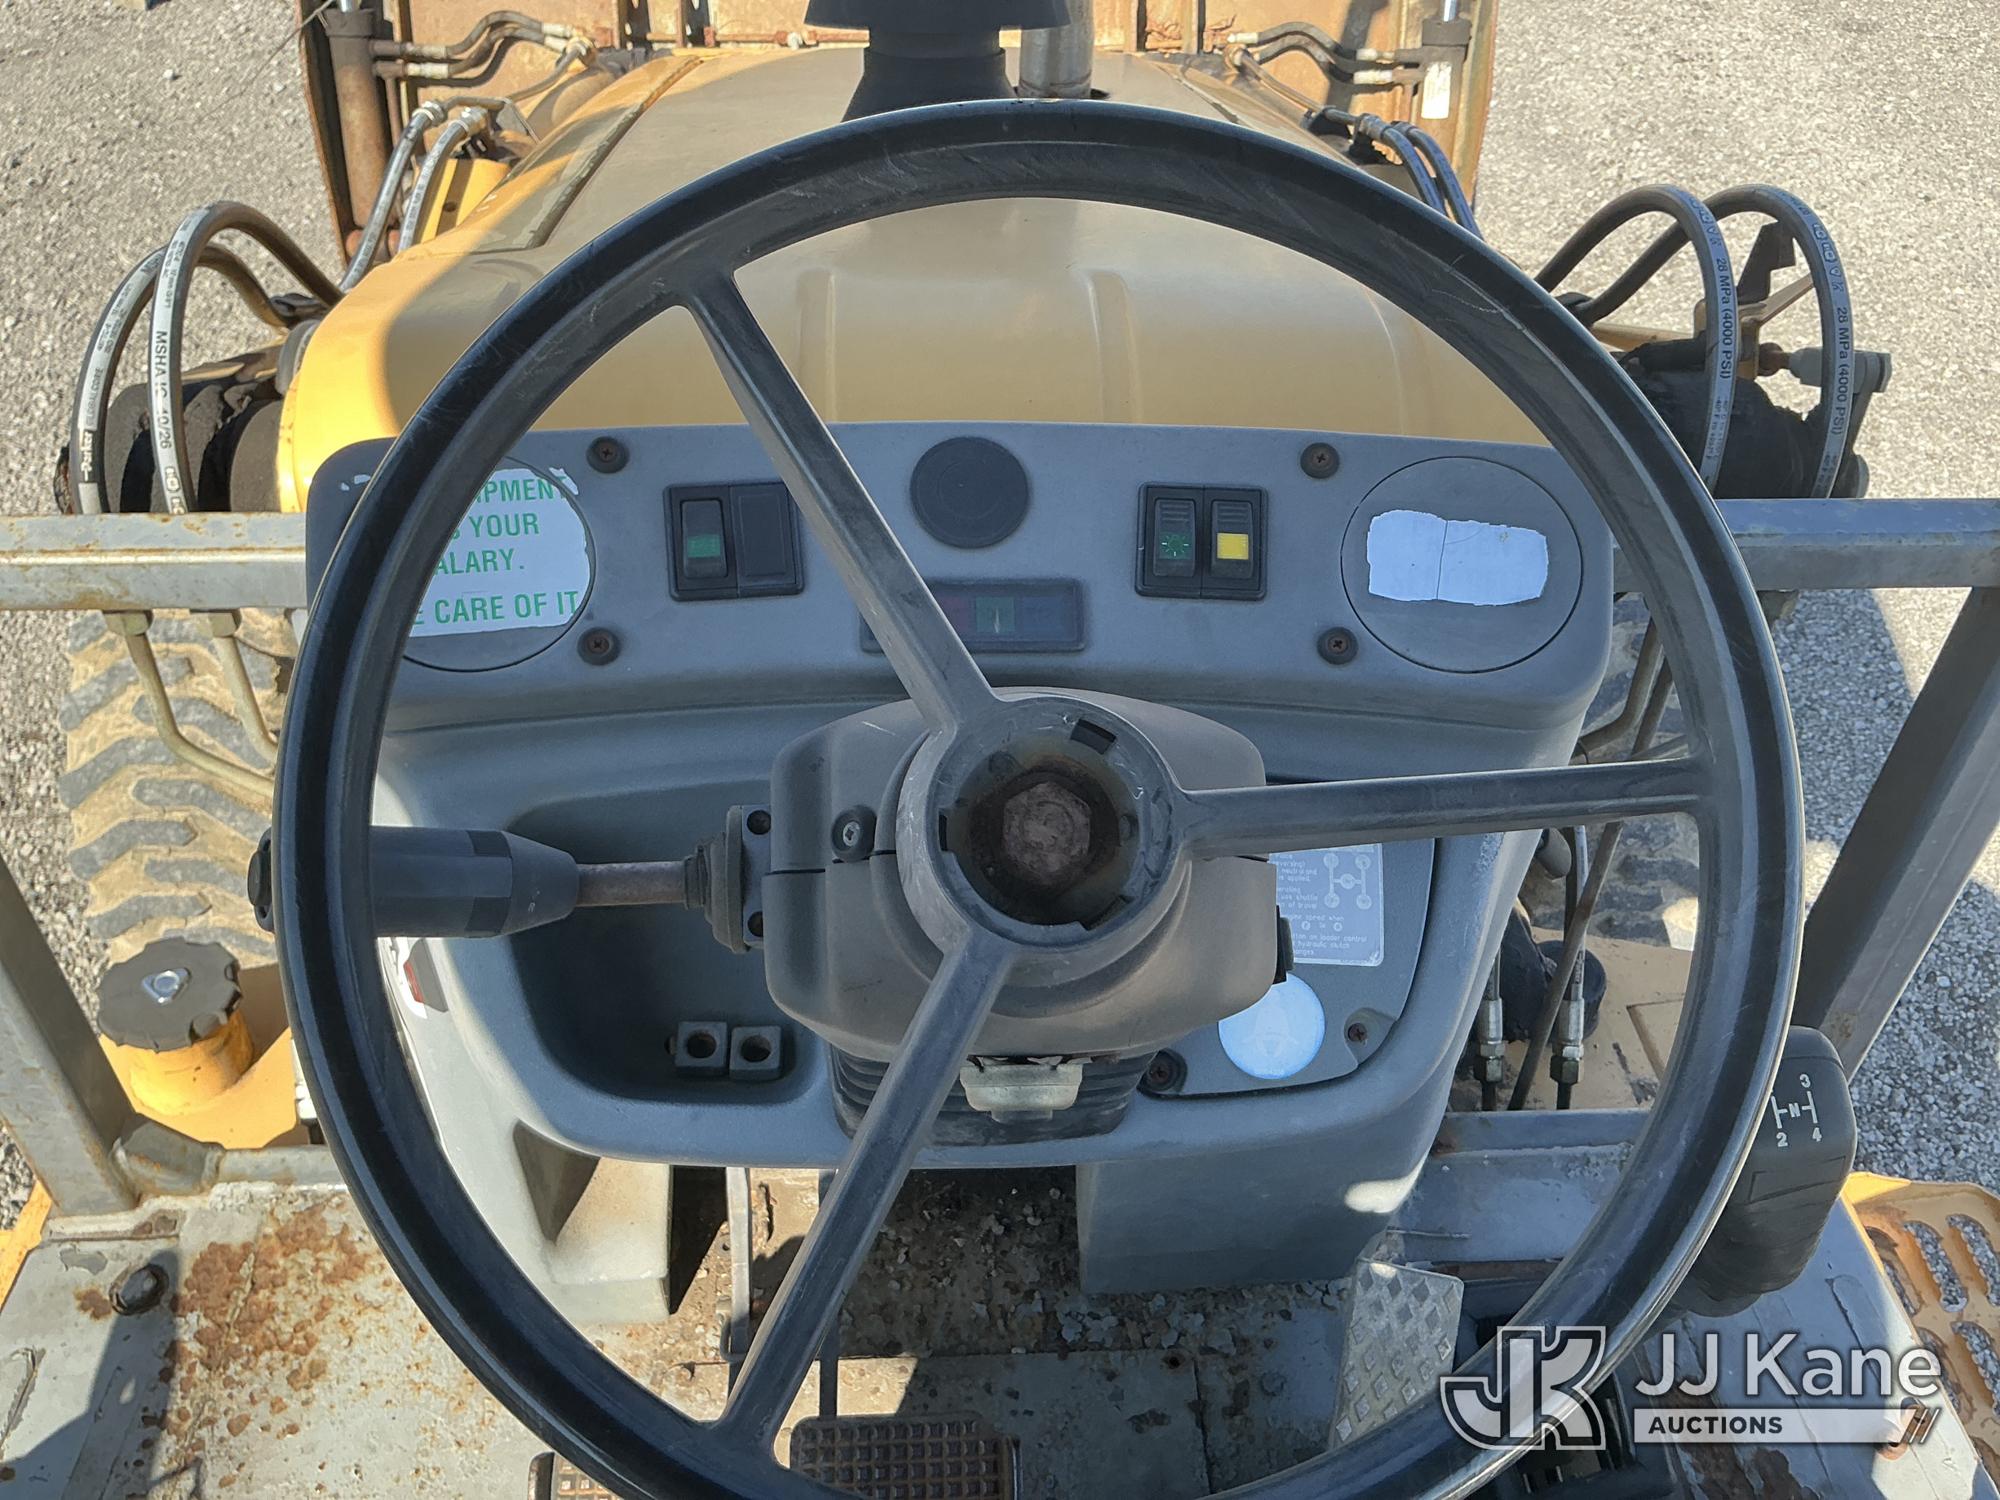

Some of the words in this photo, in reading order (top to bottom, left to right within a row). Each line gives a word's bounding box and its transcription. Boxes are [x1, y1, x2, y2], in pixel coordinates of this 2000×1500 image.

[1716, 257, 1728, 272] 28
[1719, 275, 1732, 304] MPa
[1721, 308, 1733, 345] (4000
[1837, 306, 1849, 323] 28
[154, 330, 168, 377] MSHA
[1838, 327, 1850, 359] MPa
[1720, 350, 1733, 379] PSI)
[1837, 364, 1850, 402] (4000
[1831, 407, 1846, 435] PSI)
[468, 512, 540, 538] YOUR
[434, 595, 505, 624] CARE
[514, 592, 547, 618] OF
[556, 590, 579, 615] IT
[1799, 1073, 1812, 1088] 3
[1788, 1102, 1801, 1118] N
[1775, 1132, 1789, 1148] 2
[1811, 1127, 1823, 1142] 4
